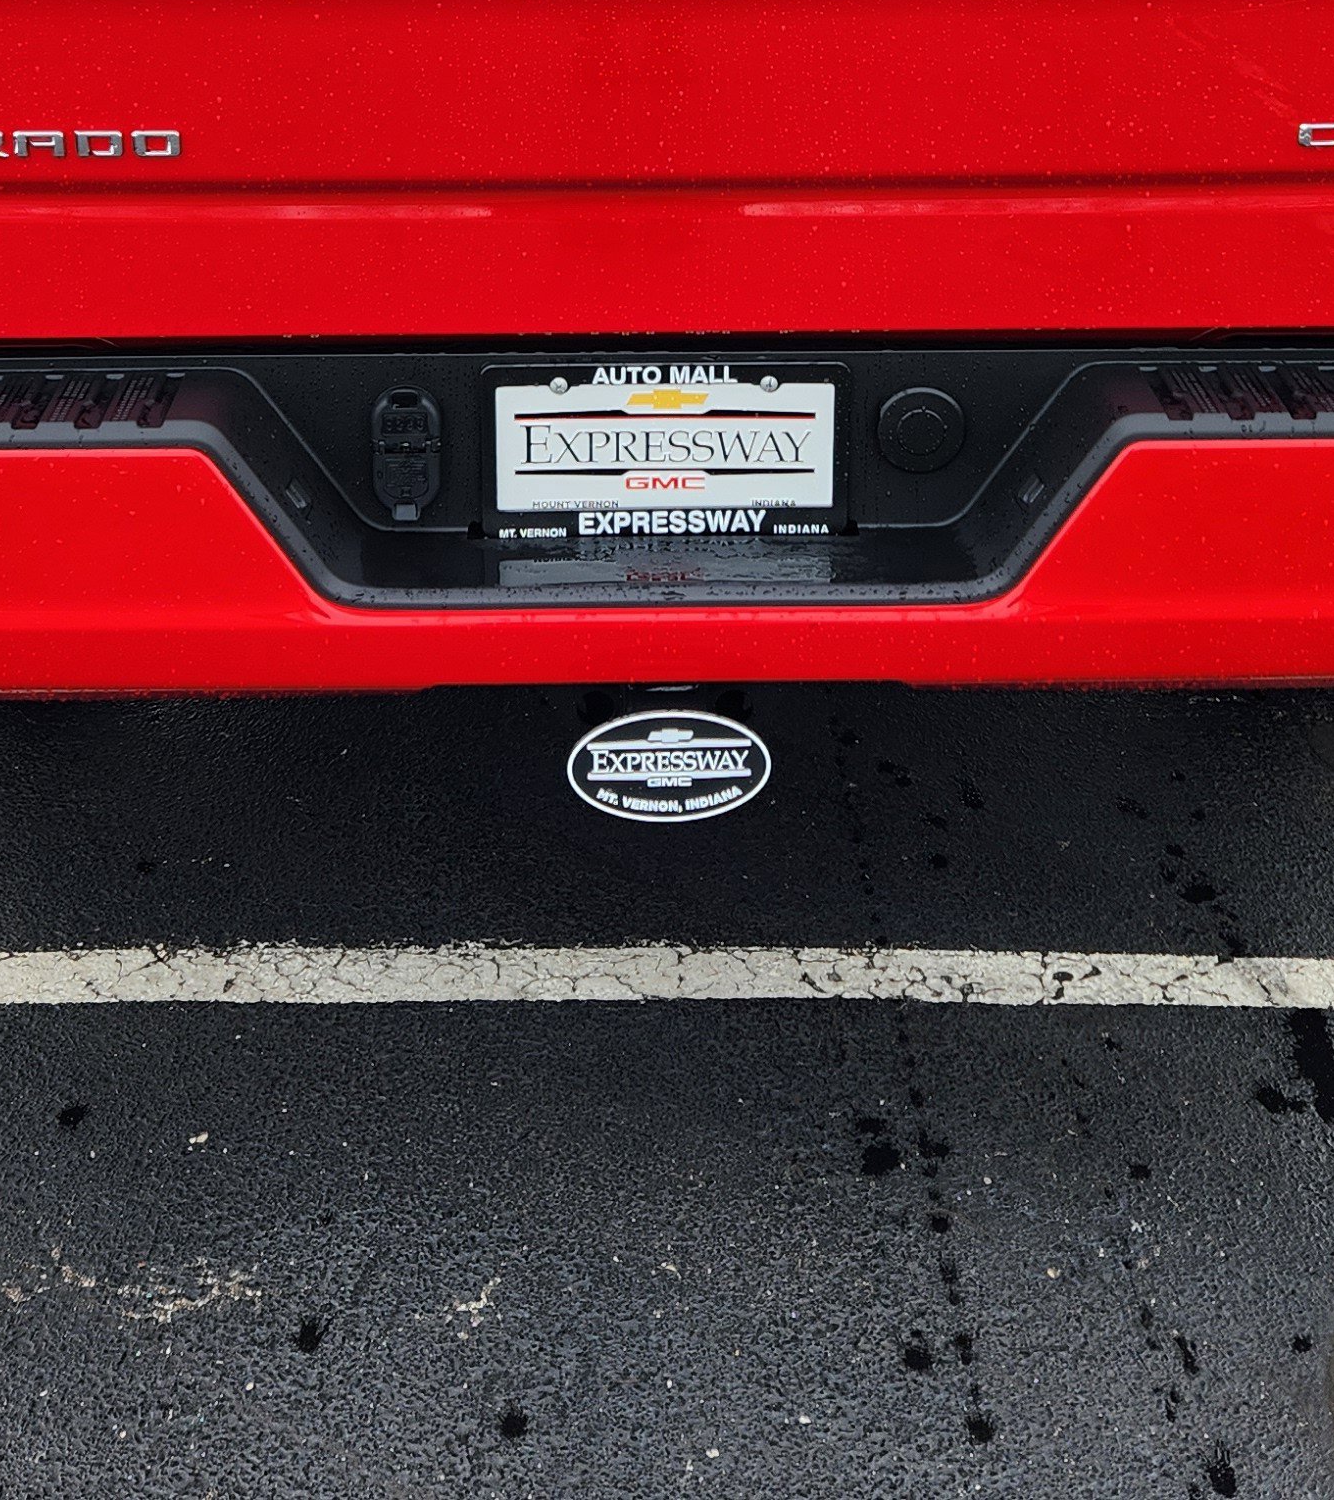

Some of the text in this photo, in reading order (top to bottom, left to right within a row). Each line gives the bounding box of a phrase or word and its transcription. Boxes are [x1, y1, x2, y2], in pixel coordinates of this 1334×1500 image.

[591, 365, 738, 386] AUTO MALL
[519, 424, 812, 465] EXPRESSWAY
[625, 476, 706, 490] GMC
[532, 500, 619, 510] MOUNT VERNON
[751, 499, 797, 508] INDIANA
[578, 509, 767, 536] EXPRESSWAY
[773, 523, 830, 535] INDIANA
[498, 526, 567, 539] MT. VERNON
[590, 750, 750, 774] EXPRESSWAY
[647, 776, 693, 788] GMC
[596, 785, 744, 813] MT. VERNON, INDIANA
